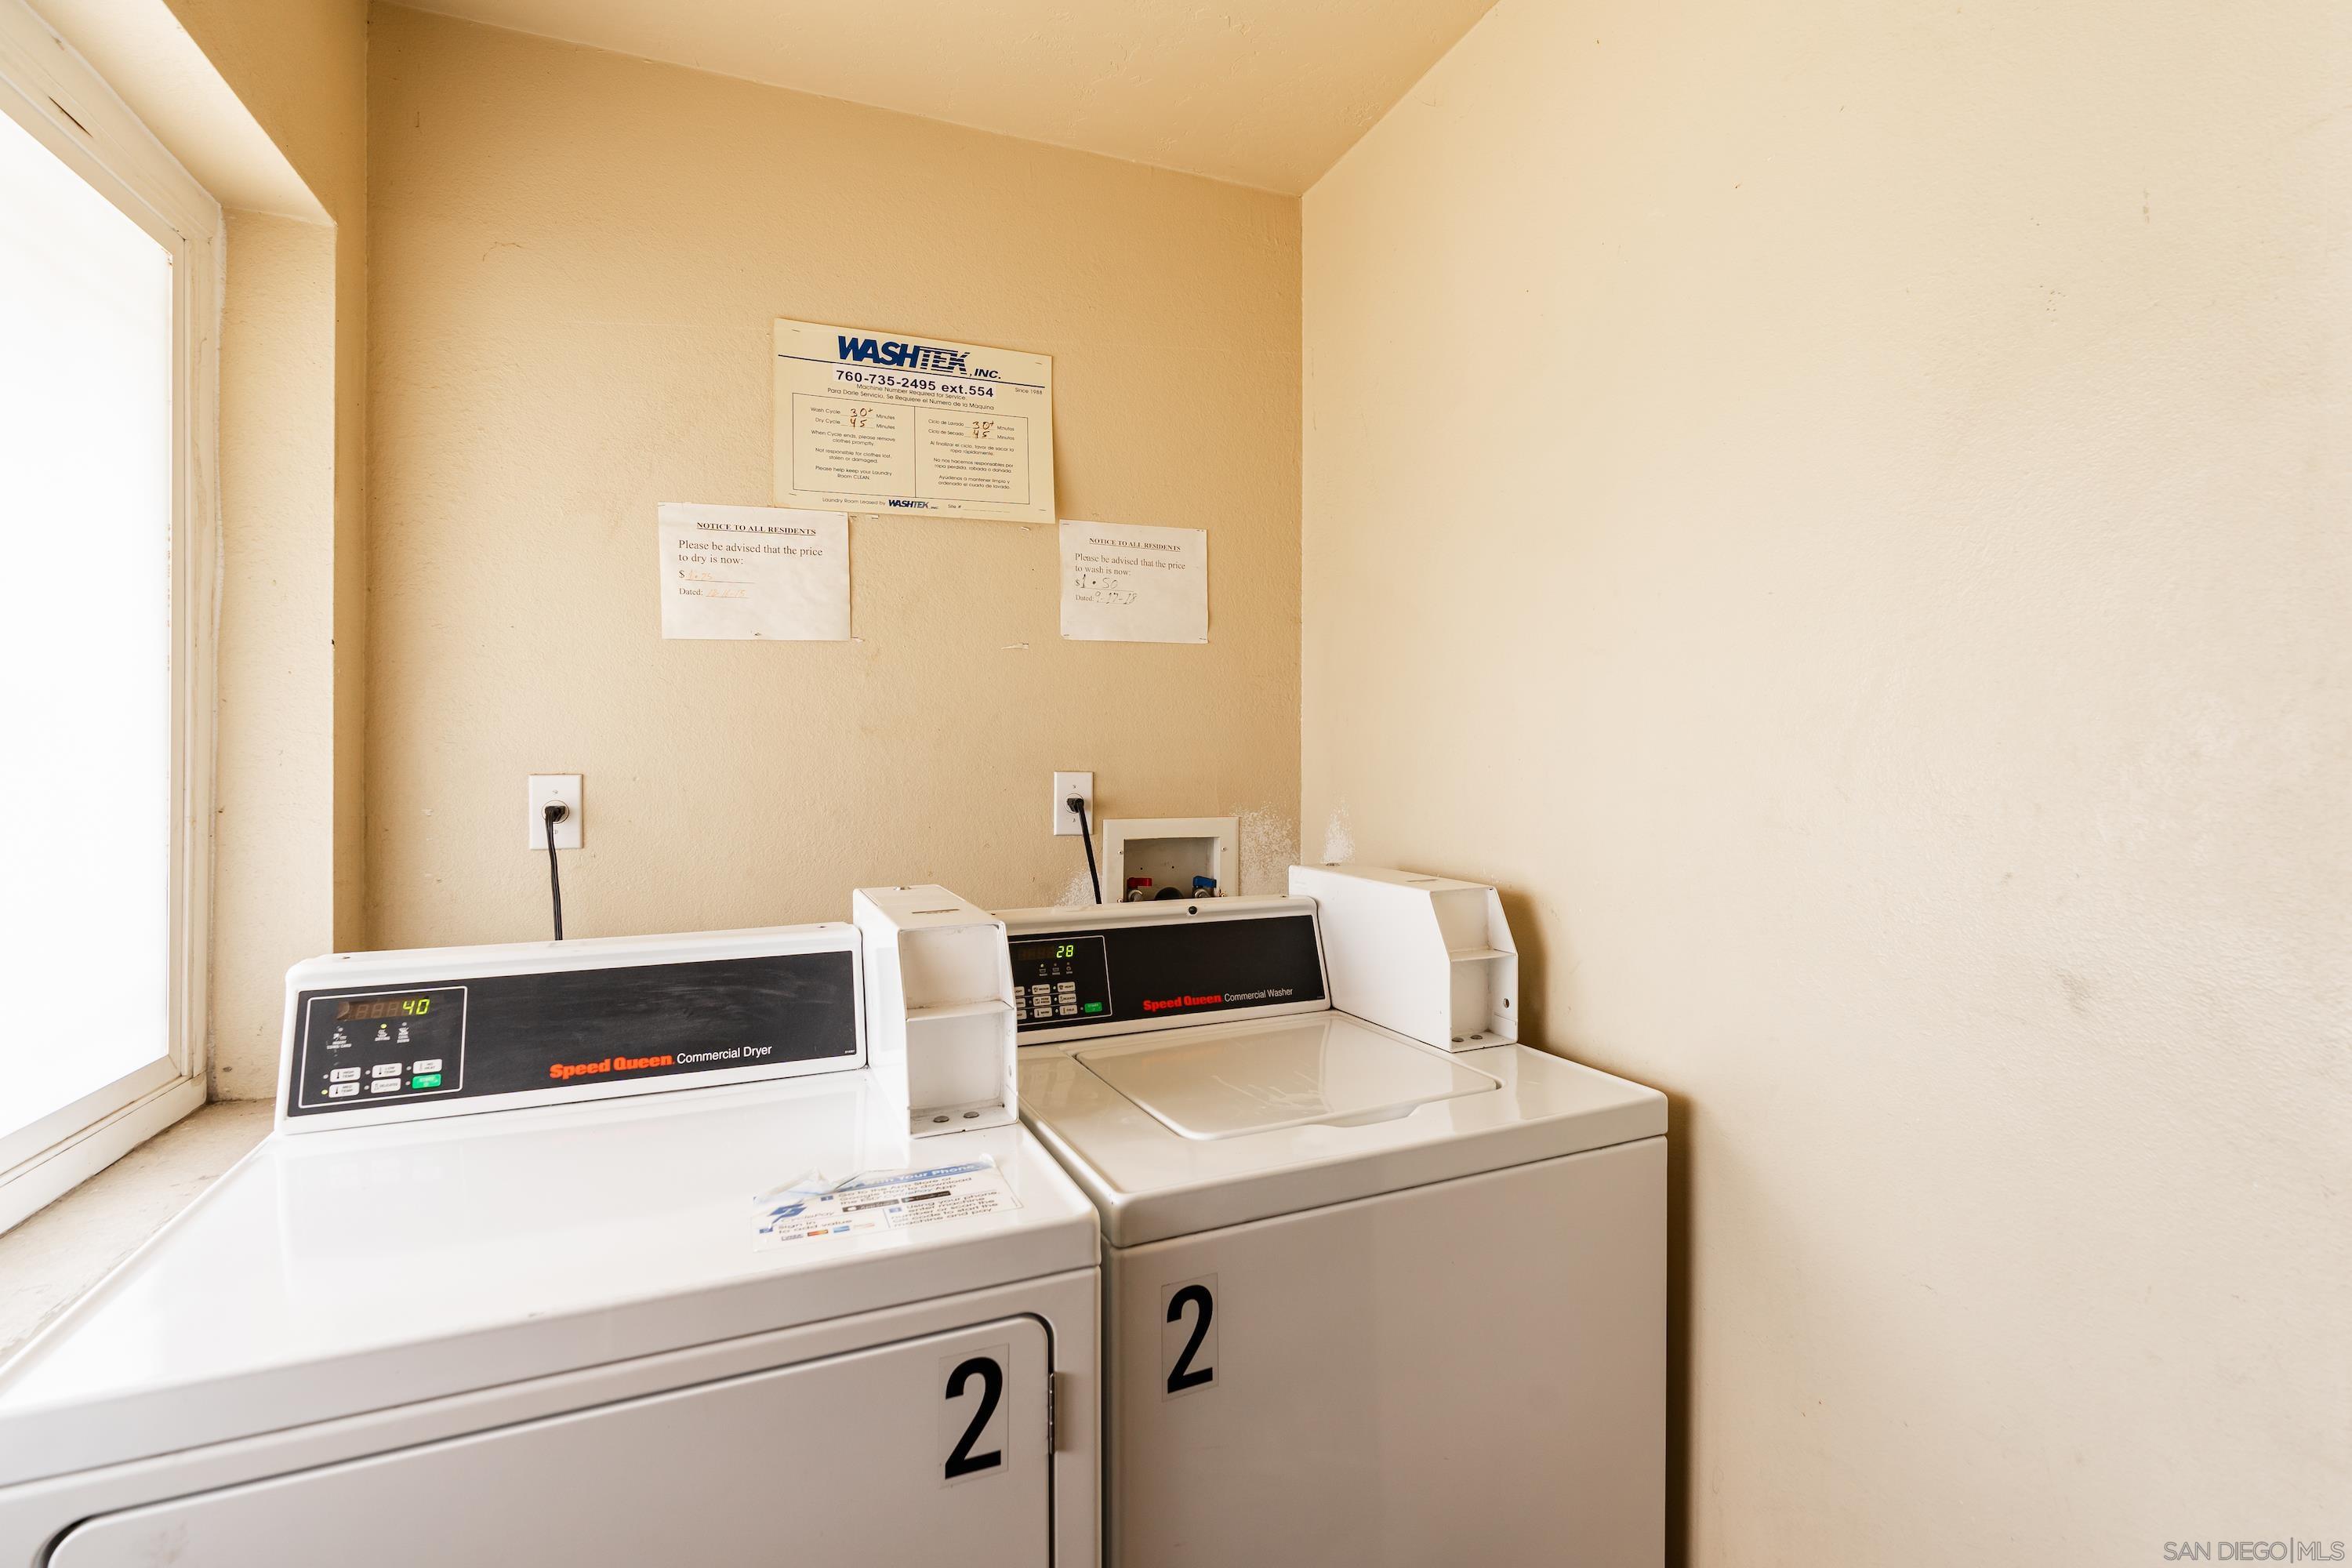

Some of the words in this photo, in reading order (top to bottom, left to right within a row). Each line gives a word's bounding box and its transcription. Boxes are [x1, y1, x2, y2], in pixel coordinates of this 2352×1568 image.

[974, 368, 1001, 379] INC.
[837, 370, 936, 391] 760-735-2495
[942, 383, 994, 397] ext.554
[861, 390, 884, 399] Servicio,
[895, 394, 920, 403] Requiere
[696, 522, 731, 531] NOTICE
[768, 527, 816, 536] RESIDENTS
[678, 539, 709, 550] Please
[712, 542, 724, 551] be
[726, 543, 760, 554] advised
[764, 545, 781, 554] that
[783, 546, 797, 555] the
[800, 546, 823, 558] price
[1144, 543, 1181, 551] RESIDENTS
[691, 554, 707, 564] dry
[710, 555, 717, 564] is
[1075, 553, 1099, 562] Please
[1111, 557, 1138, 565] advised
[1168, 561, 1185, 570] price
[678, 587, 703, 597] Dated:
[1056, 945, 1074, 958] 28
[402, 998, 430, 1015] 40
[1142, 996, 1181, 1012] Speed
[1183, 994, 1221, 1006] Queen
[1224, 990, 1266, 1003] Commercial
[1267, 988, 1293, 998] Washer
[549, 1058, 611, 1080] Speed
[613, 1054, 673, 1071] Queen
[677, 1047, 741, 1065] Commercial
[743, 1045, 772, 1060] Dryer
[1167, 1284, 1214, 1395] 2
[945, 1356, 1004, 1480] 2
